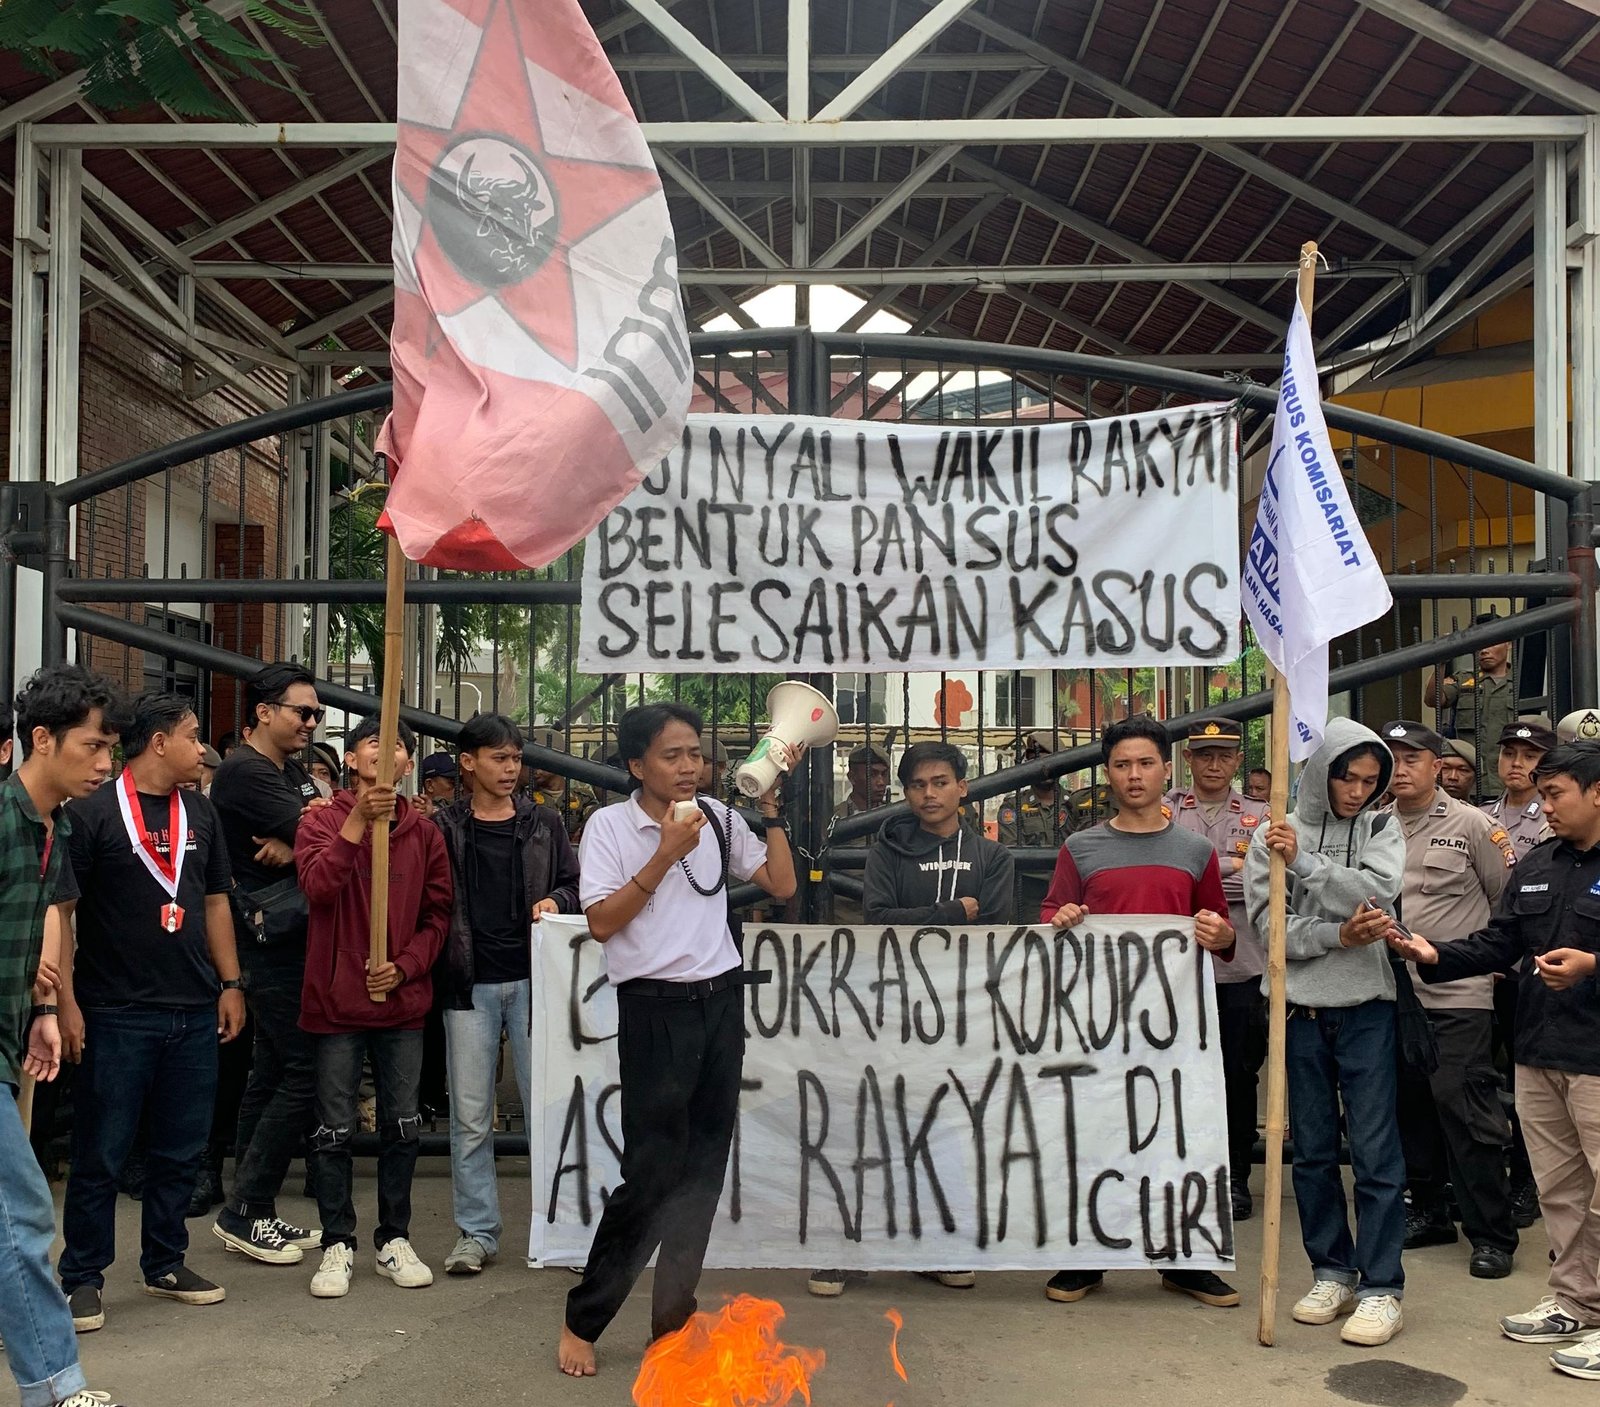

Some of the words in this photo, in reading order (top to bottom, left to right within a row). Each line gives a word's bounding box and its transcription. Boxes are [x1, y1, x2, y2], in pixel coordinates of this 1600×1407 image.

[709, 423, 867, 502] NYALI
[885, 424, 1053, 506] WAKIL
[1067, 410, 1230, 497] RAKYAT
[1294, 430, 1361, 567] KOMISARIAT
[599, 499, 833, 580] BENTUK
[851, 503, 1079, 578] PANSUS
[598, 574, 988, 666] SELESAIKAN
[1008, 562, 1229, 661] KASUS
[1231, 827, 1253, 837] POL
[1430, 838, 1466, 851] POLRI
[1517, 835, 1537, 846] POL
[984, 925, 1207, 1056] KORUPSI
[799, 1056, 1099, 1252] RAKYAT
[1125, 1064, 1187, 1161] DI
[1087, 1164, 1234, 1264] CURI
